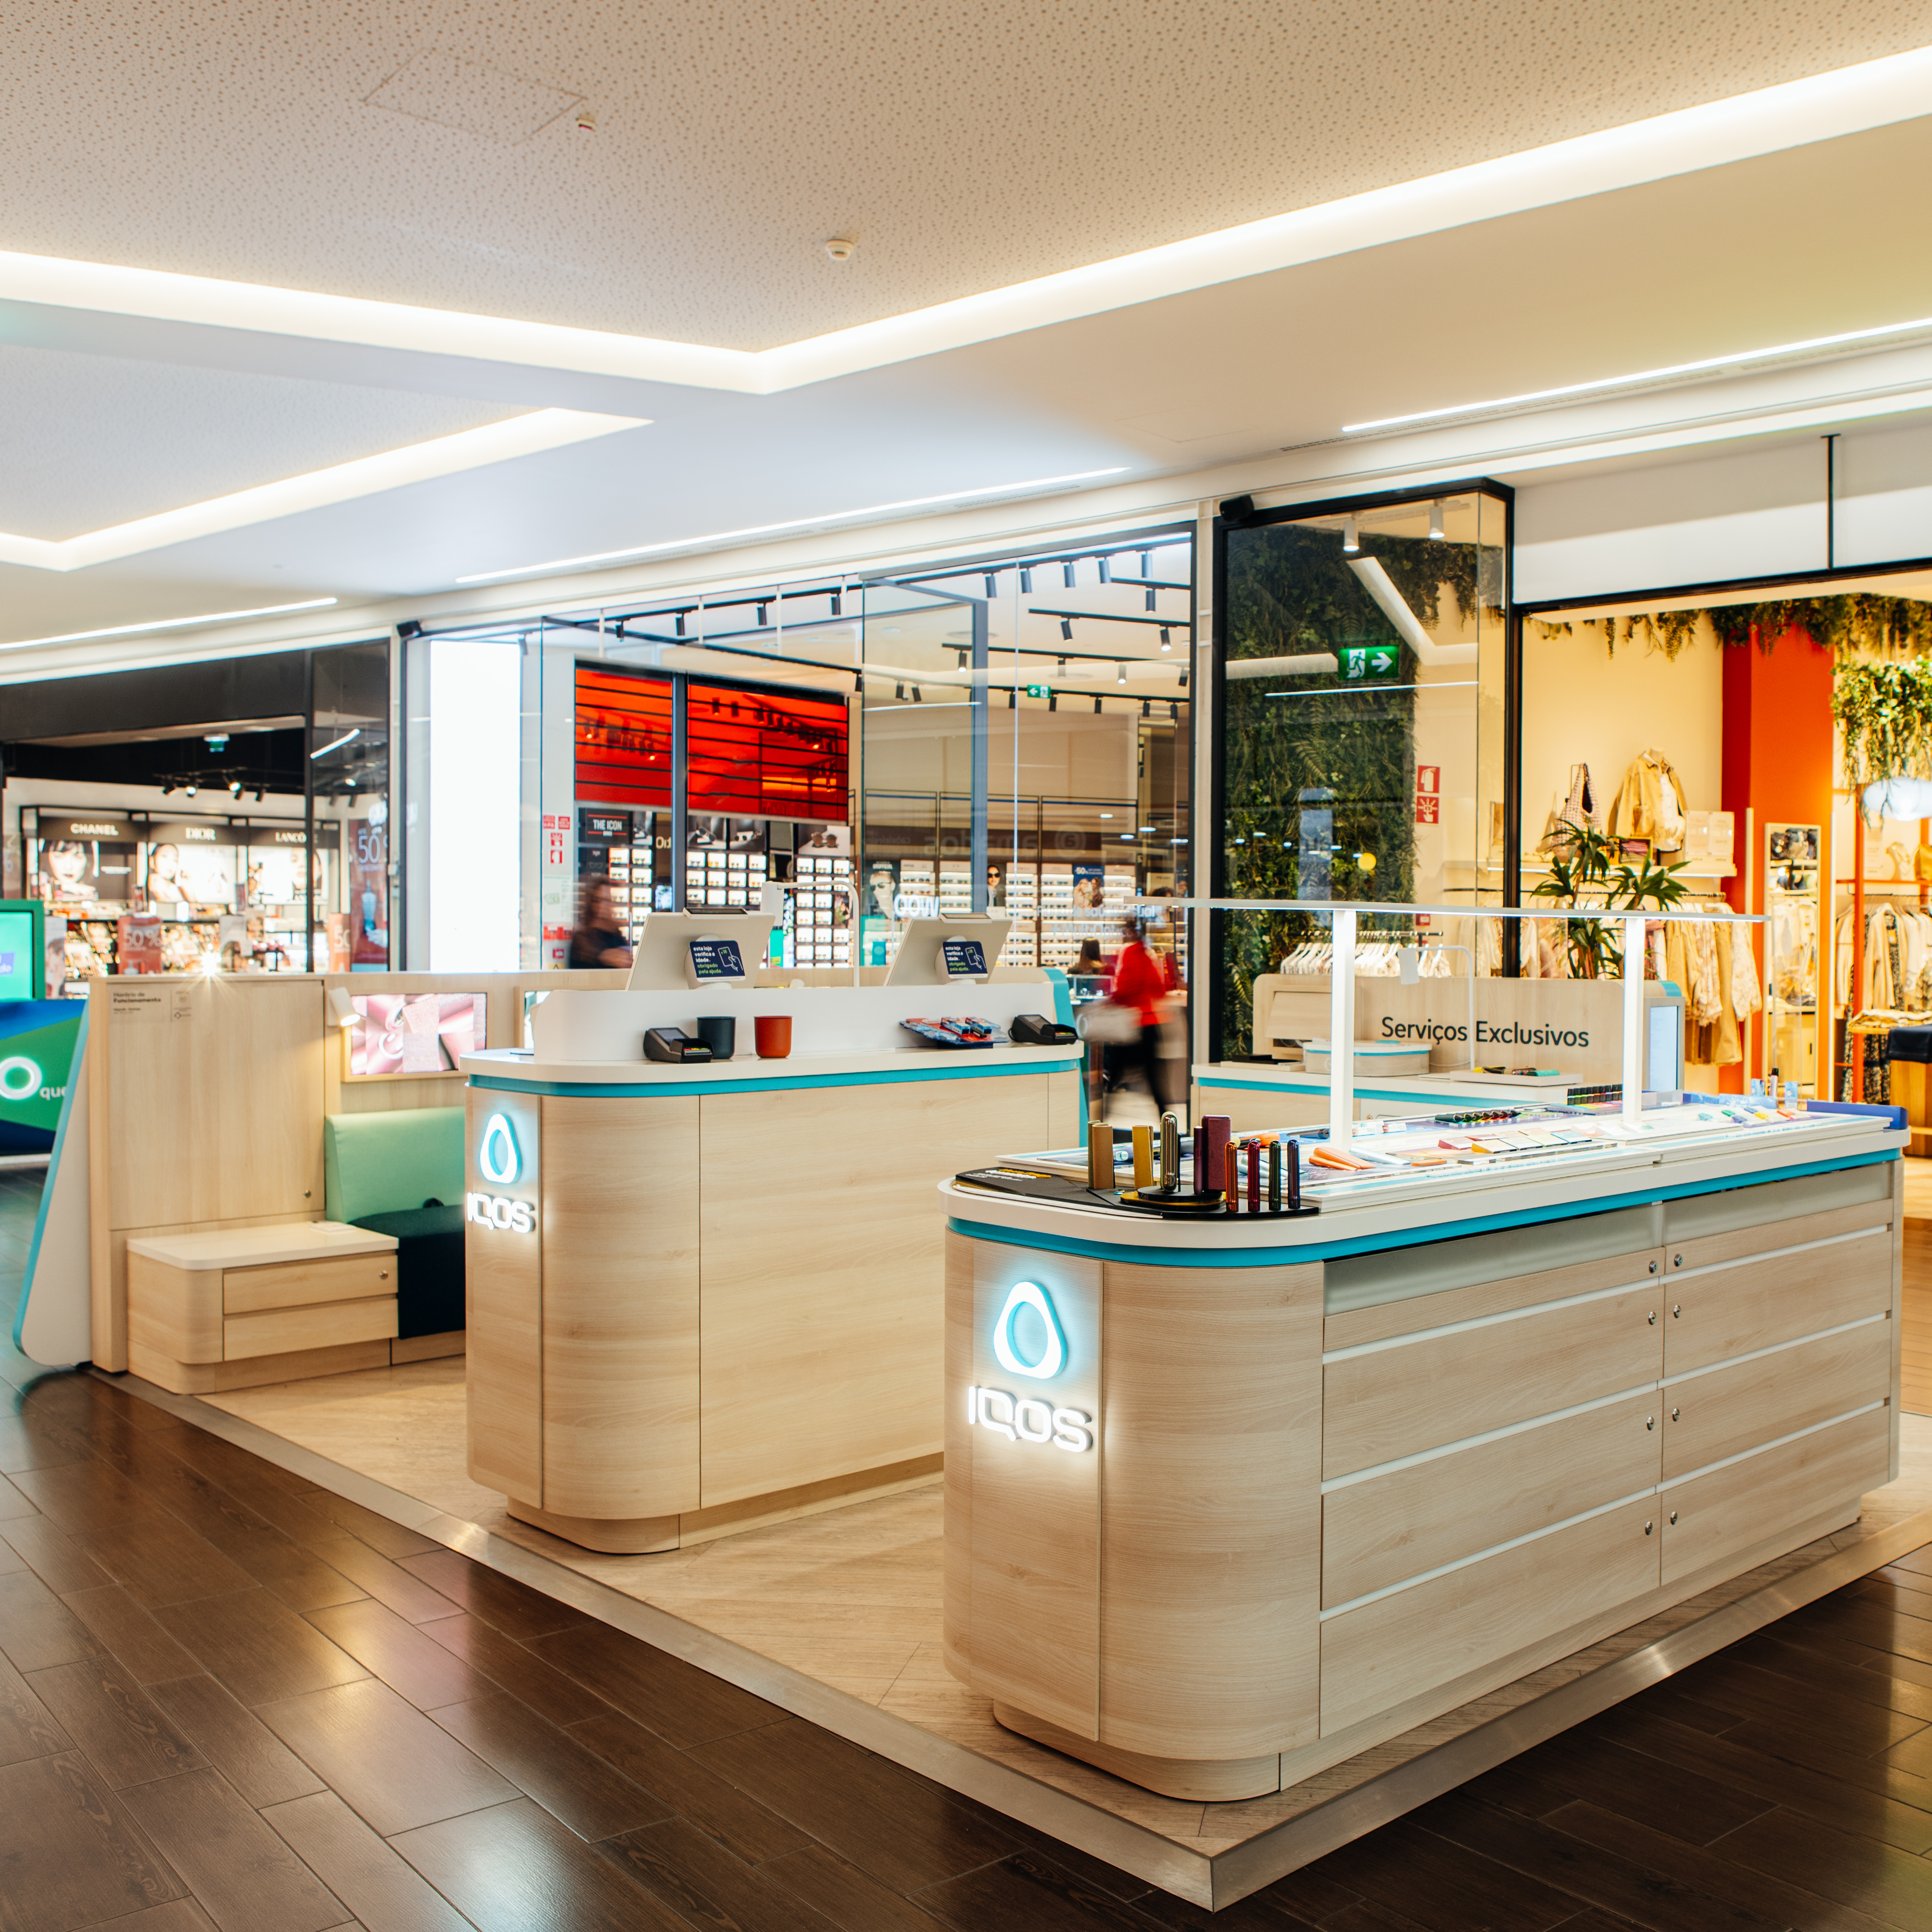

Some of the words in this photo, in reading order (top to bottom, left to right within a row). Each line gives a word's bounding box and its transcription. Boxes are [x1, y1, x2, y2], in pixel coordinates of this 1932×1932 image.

[71, 824, 119, 836] CHANEL
[185, 827, 216, 840] DIOR
[593, 819, 606, 830] THE
[607, 820, 622, 831] ICON
[1381, 1017, 1467, 1045] Serviços
[1476, 1021, 1589, 1047] Exclusivos
[467, 1192, 533, 1233] IQOS
[968, 1386, 1092, 1452] IQOS
